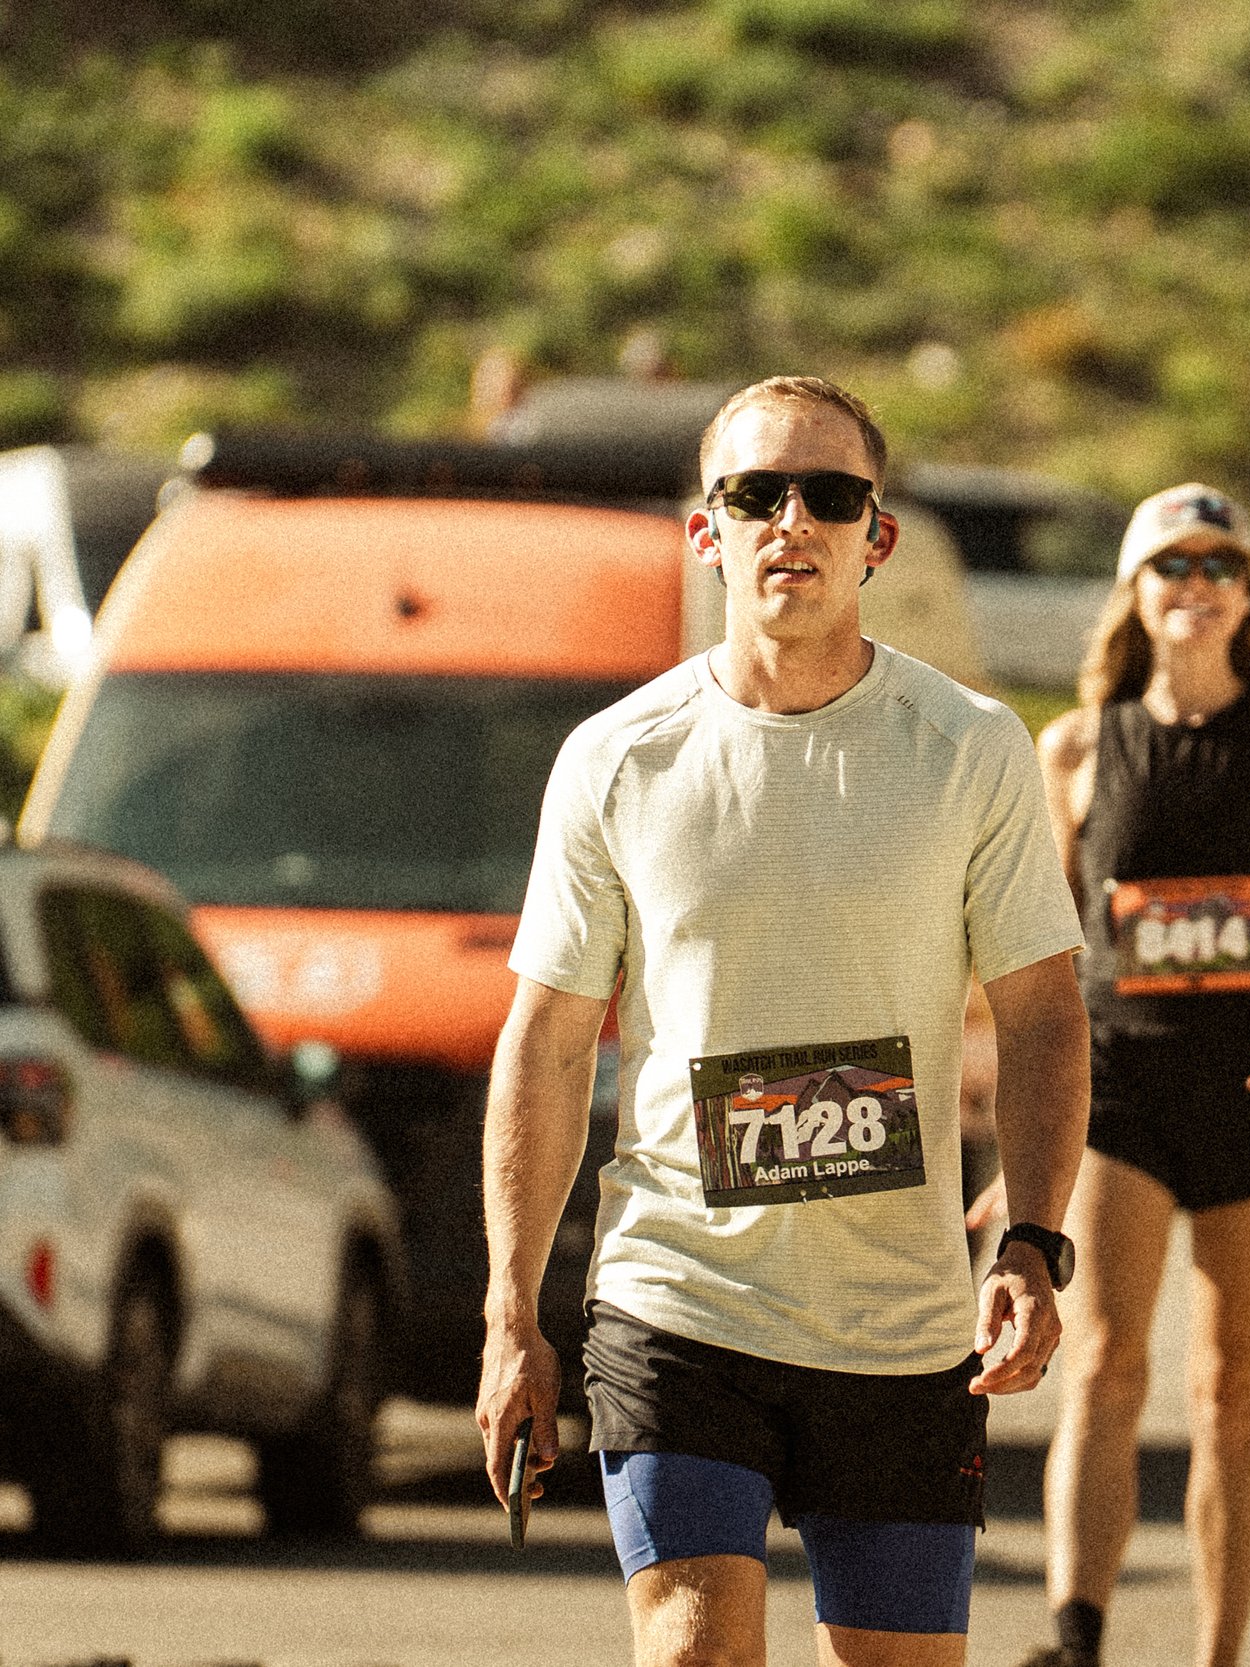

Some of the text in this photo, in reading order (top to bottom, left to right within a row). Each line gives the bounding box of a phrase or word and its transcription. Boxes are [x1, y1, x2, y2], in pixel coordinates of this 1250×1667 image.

[721, 1043, 878, 1074] WASATCH TRAIL RUN SERIES
[729, 1097, 886, 1164] 7128
[755, 1158, 870, 1183] Adam Lappe
